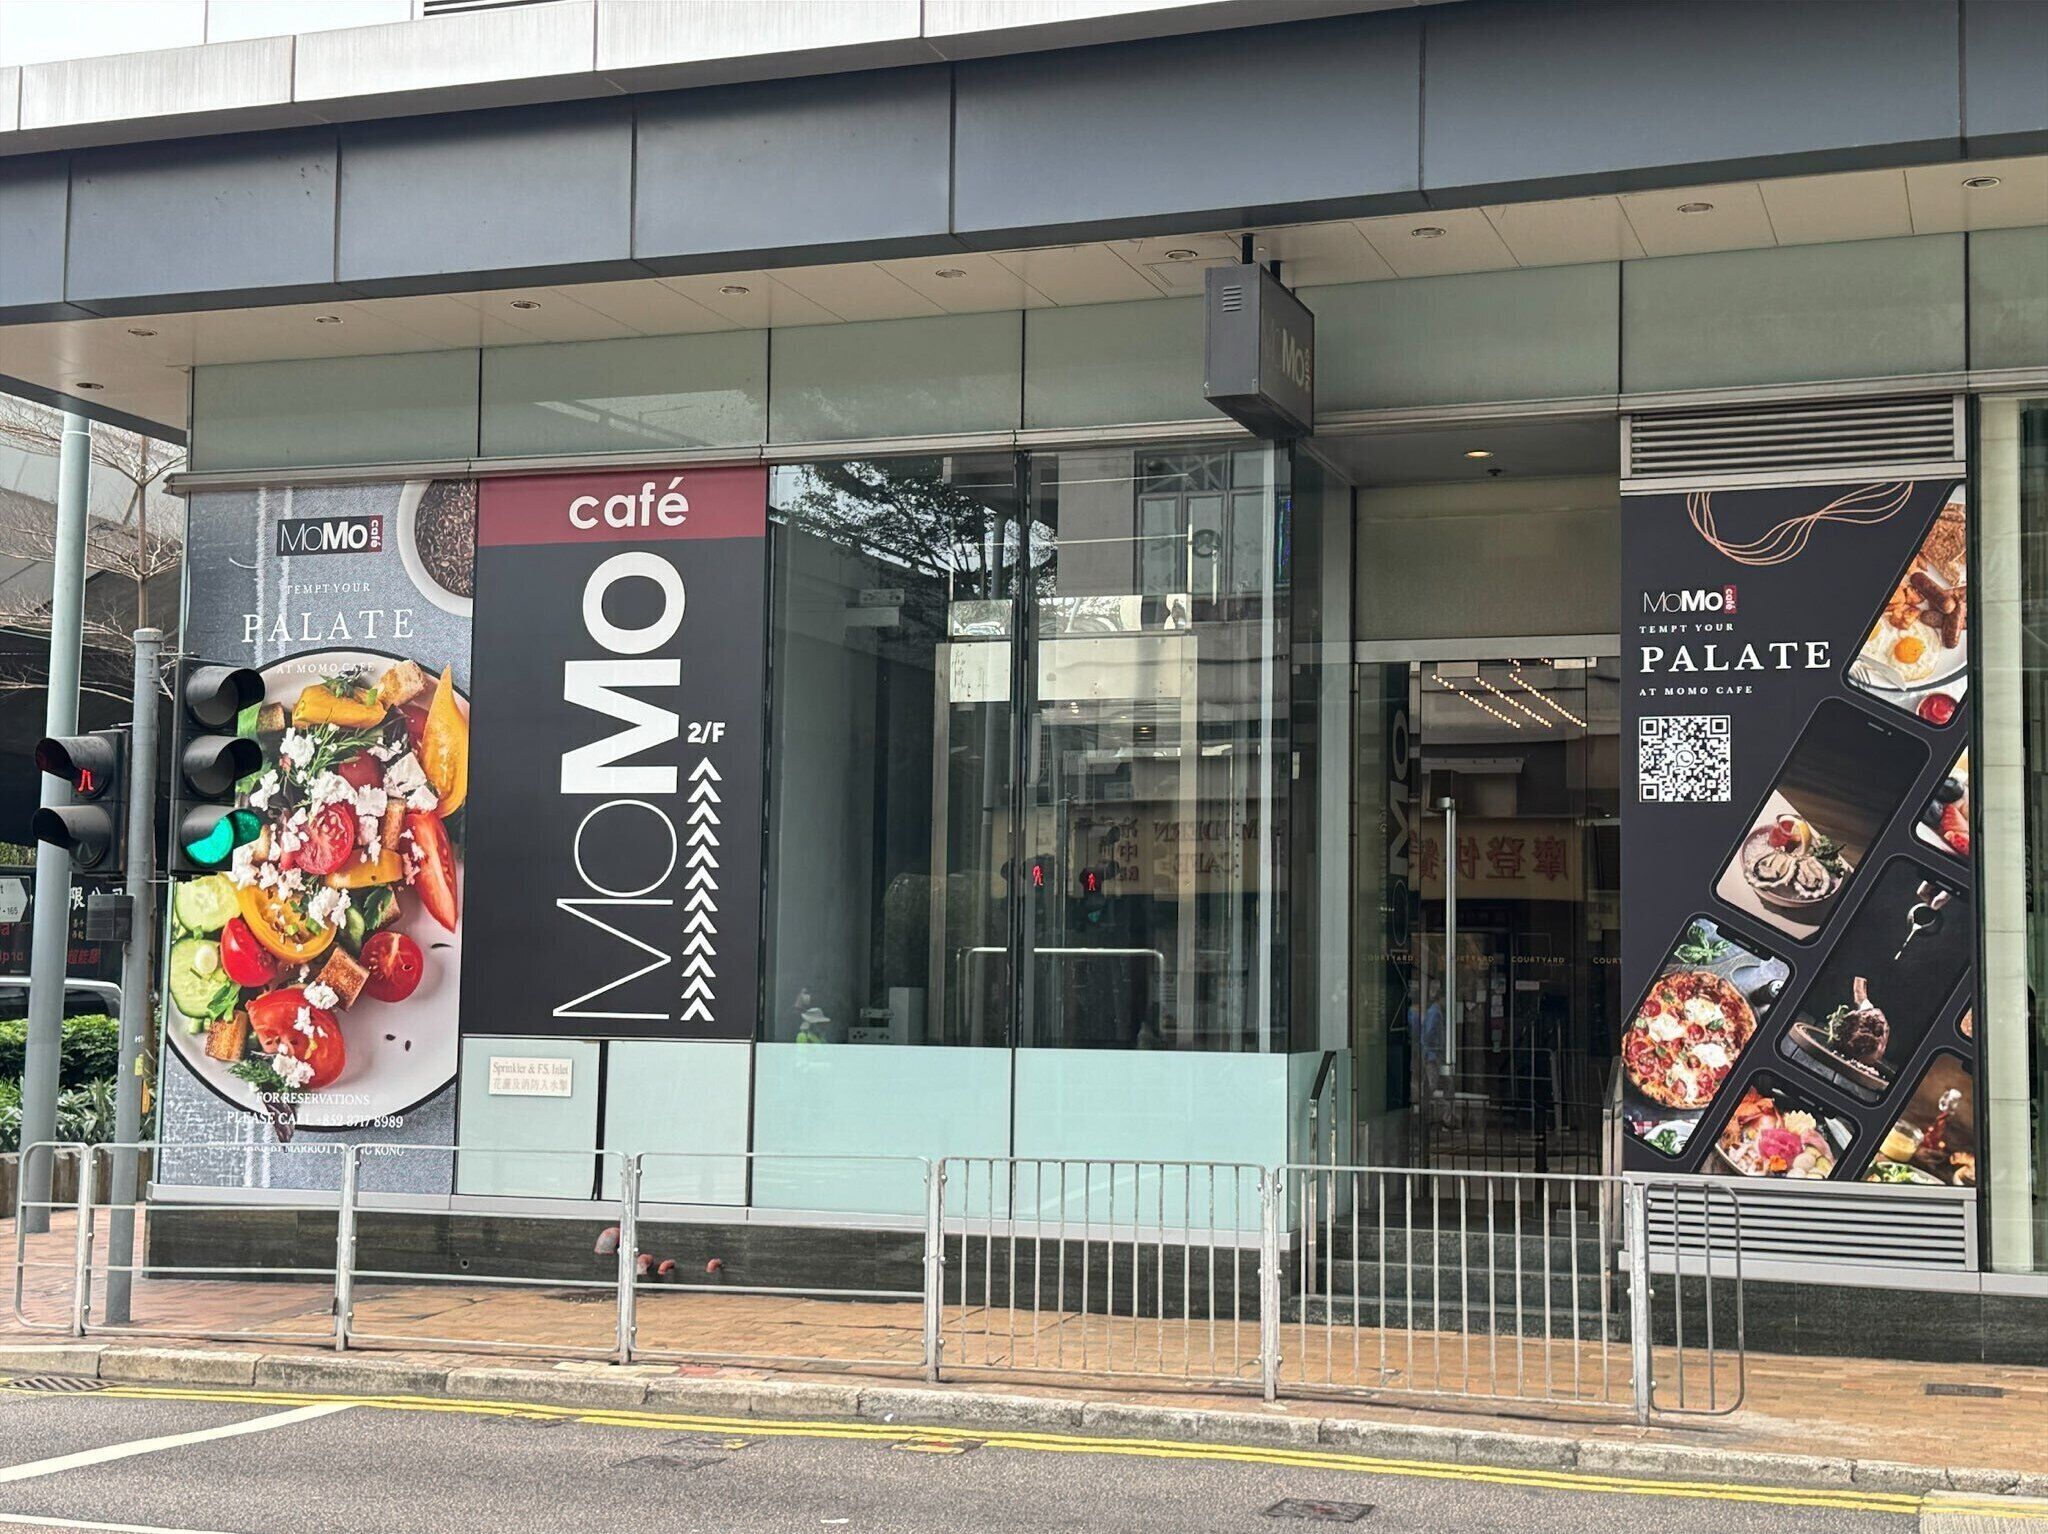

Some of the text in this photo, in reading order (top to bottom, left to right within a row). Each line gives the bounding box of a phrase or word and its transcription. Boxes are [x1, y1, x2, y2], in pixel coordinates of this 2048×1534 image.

[568, 476, 689, 529] café
[370, 519, 382, 549] café
[286, 582, 371, 595] TEMPT YOUR
[241, 608, 414, 643] PALATE
[1639, 623, 1734, 634] TEMPT YOUR
[1639, 641, 1832, 673] PALATE
[276, 664, 293, 674] AT
[296, 663, 338, 673] MOMO
[1639, 685, 1753, 697] AT MOMO CAFE
[687, 721, 726, 745] 2/F
[492, 1062, 526, 1075] Sprinkler
[528, 1063, 535, 1074] &
[256, 1092, 370, 1106] FOR RESERVATIONS
[227, 1111, 275, 1125] PLEASE
[278, 1112, 310, 1126] CALL
[373, 1115, 404, 1129] 8989
